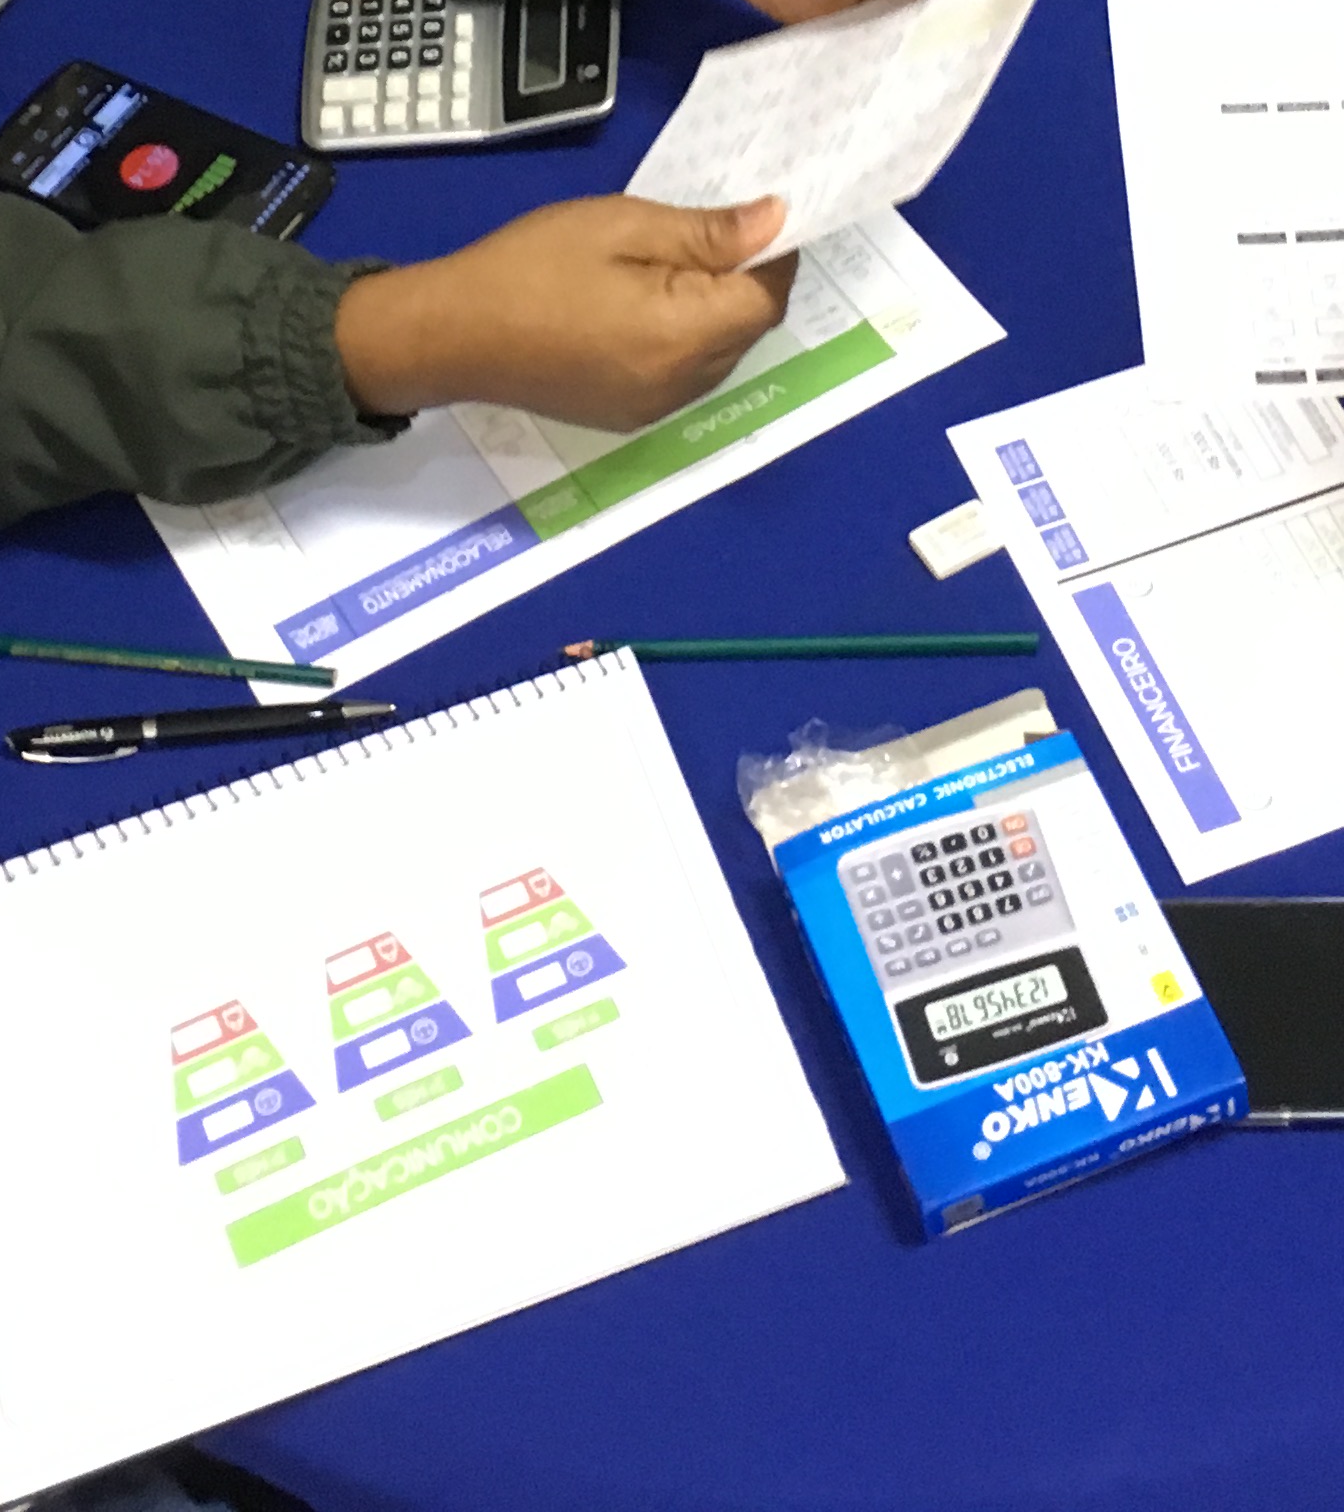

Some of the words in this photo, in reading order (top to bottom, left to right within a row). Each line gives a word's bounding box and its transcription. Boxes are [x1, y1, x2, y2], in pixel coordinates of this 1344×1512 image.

[682, 382, 787, 445] VENDAS
[1112, 637, 1202, 775] FINANCEIRO
[935, 751, 1035, 803] ELECTRONIC
[819, 792, 927, 845] CALCULATOR
[944, 976, 1049, 1032] 12345678
[993, 1041, 1111, 1102] KK-800A
[307, 1106, 523, 1222] COMUNICAÇÃO
